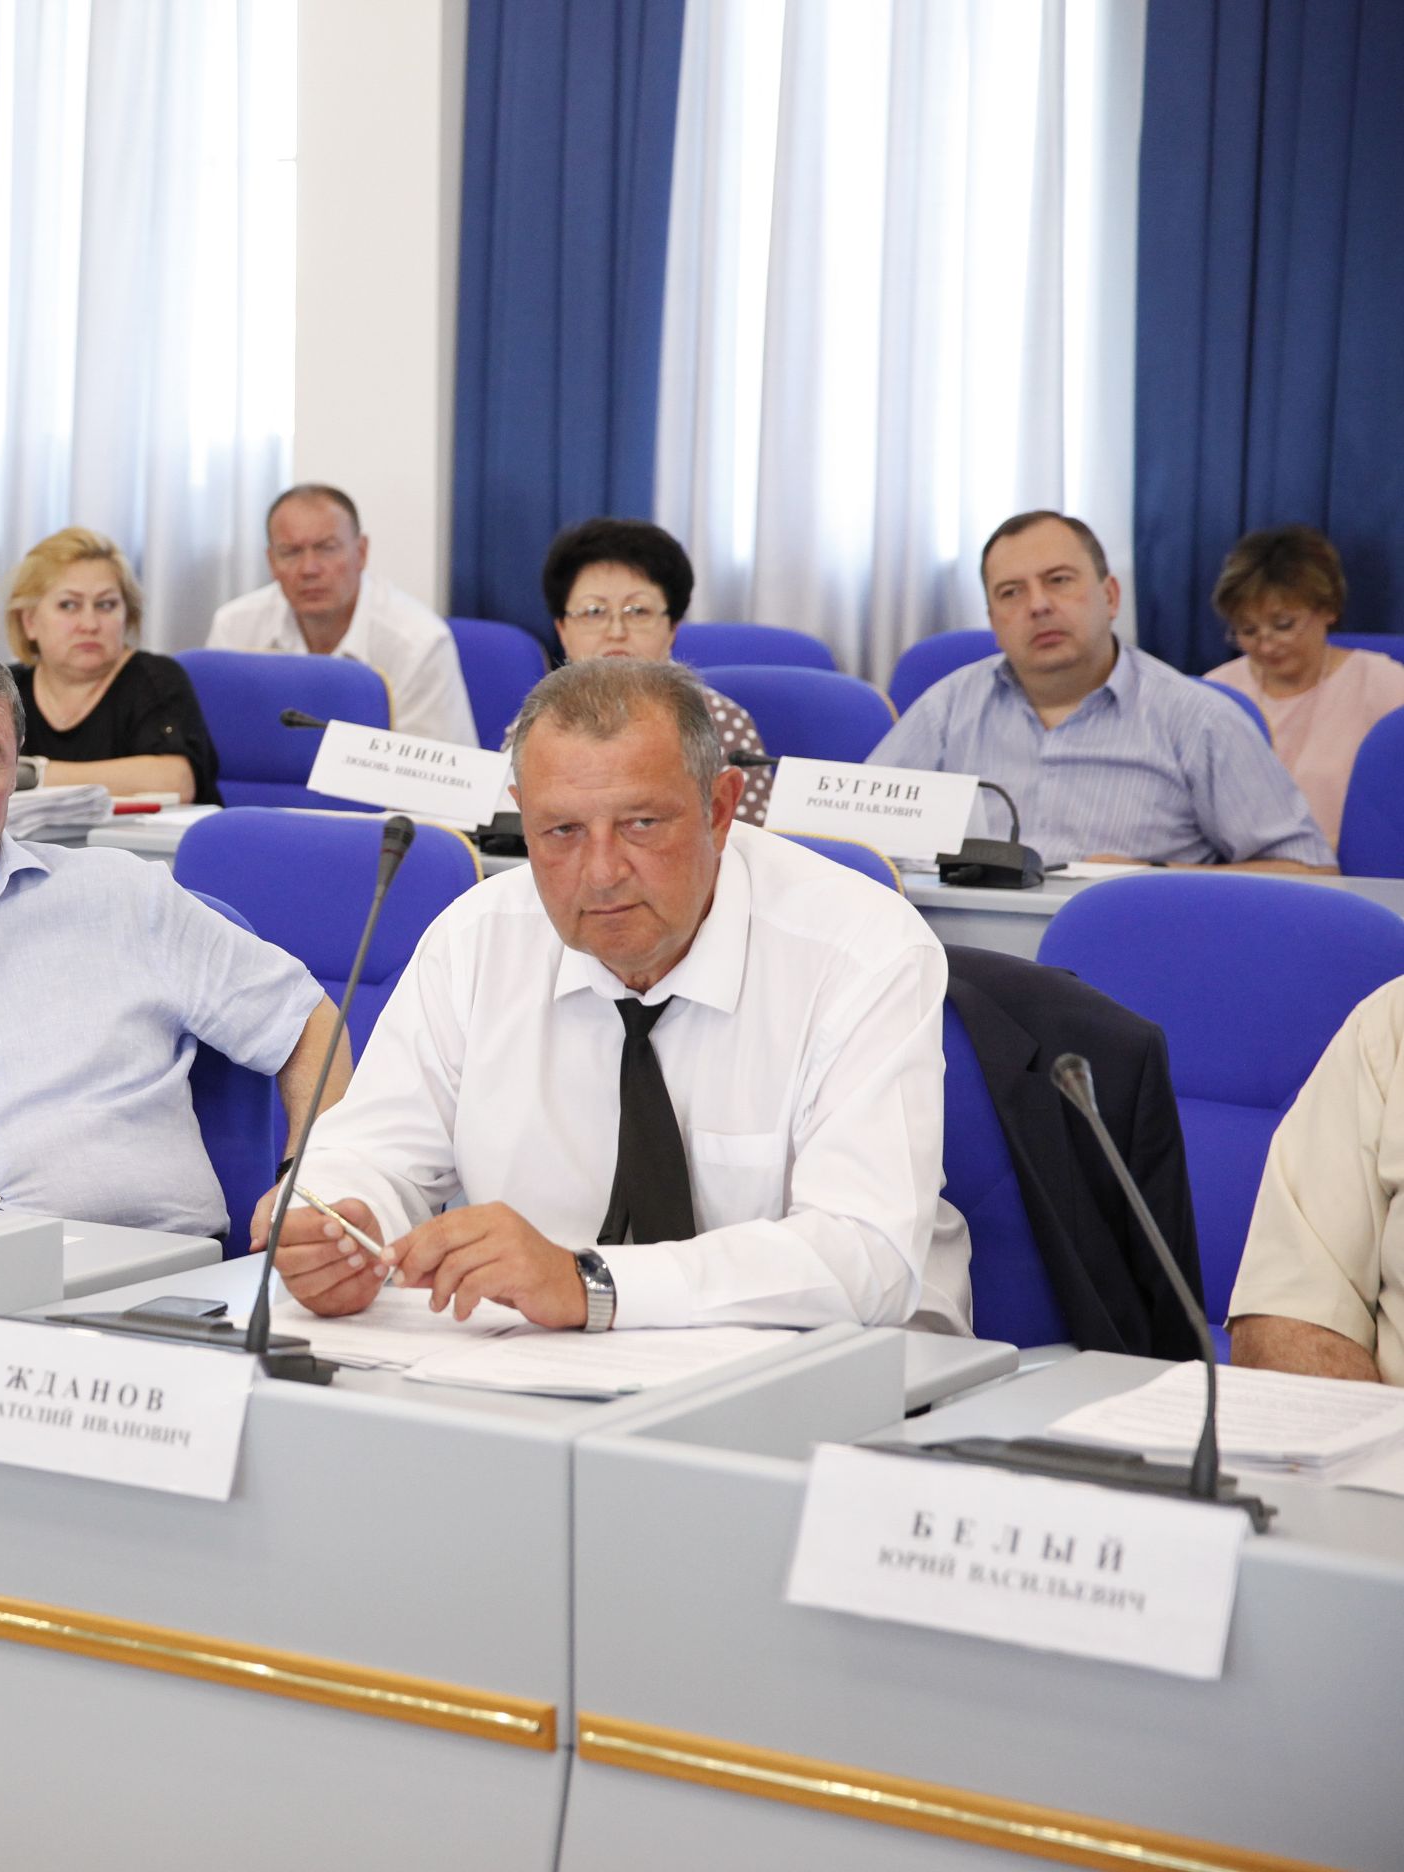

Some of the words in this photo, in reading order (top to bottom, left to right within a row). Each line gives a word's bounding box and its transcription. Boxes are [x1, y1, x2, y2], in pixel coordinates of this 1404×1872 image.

[369, 738, 457, 767] БУНИНА
[343, 756, 390, 772] ЛЮБОВЬ
[395, 765, 472, 790] НИКОЛАЕВНА
[817, 776, 922, 801] БУГРИН
[807, 797, 850, 811] РОМАН
[854, 801, 923, 819] ПАВЛОВИЧ
[5, 1364, 165, 1413] ЖДАНОВ
[81, 1413, 192, 1449] ИВАНОВИЧ
[912, 1510, 1125, 1573] БЕЛЫЙ
[877, 1546, 957, 1578] ЮРИЙ
[968, 1564, 1147, 1614] ВАСИЛЬЕВИЧ
